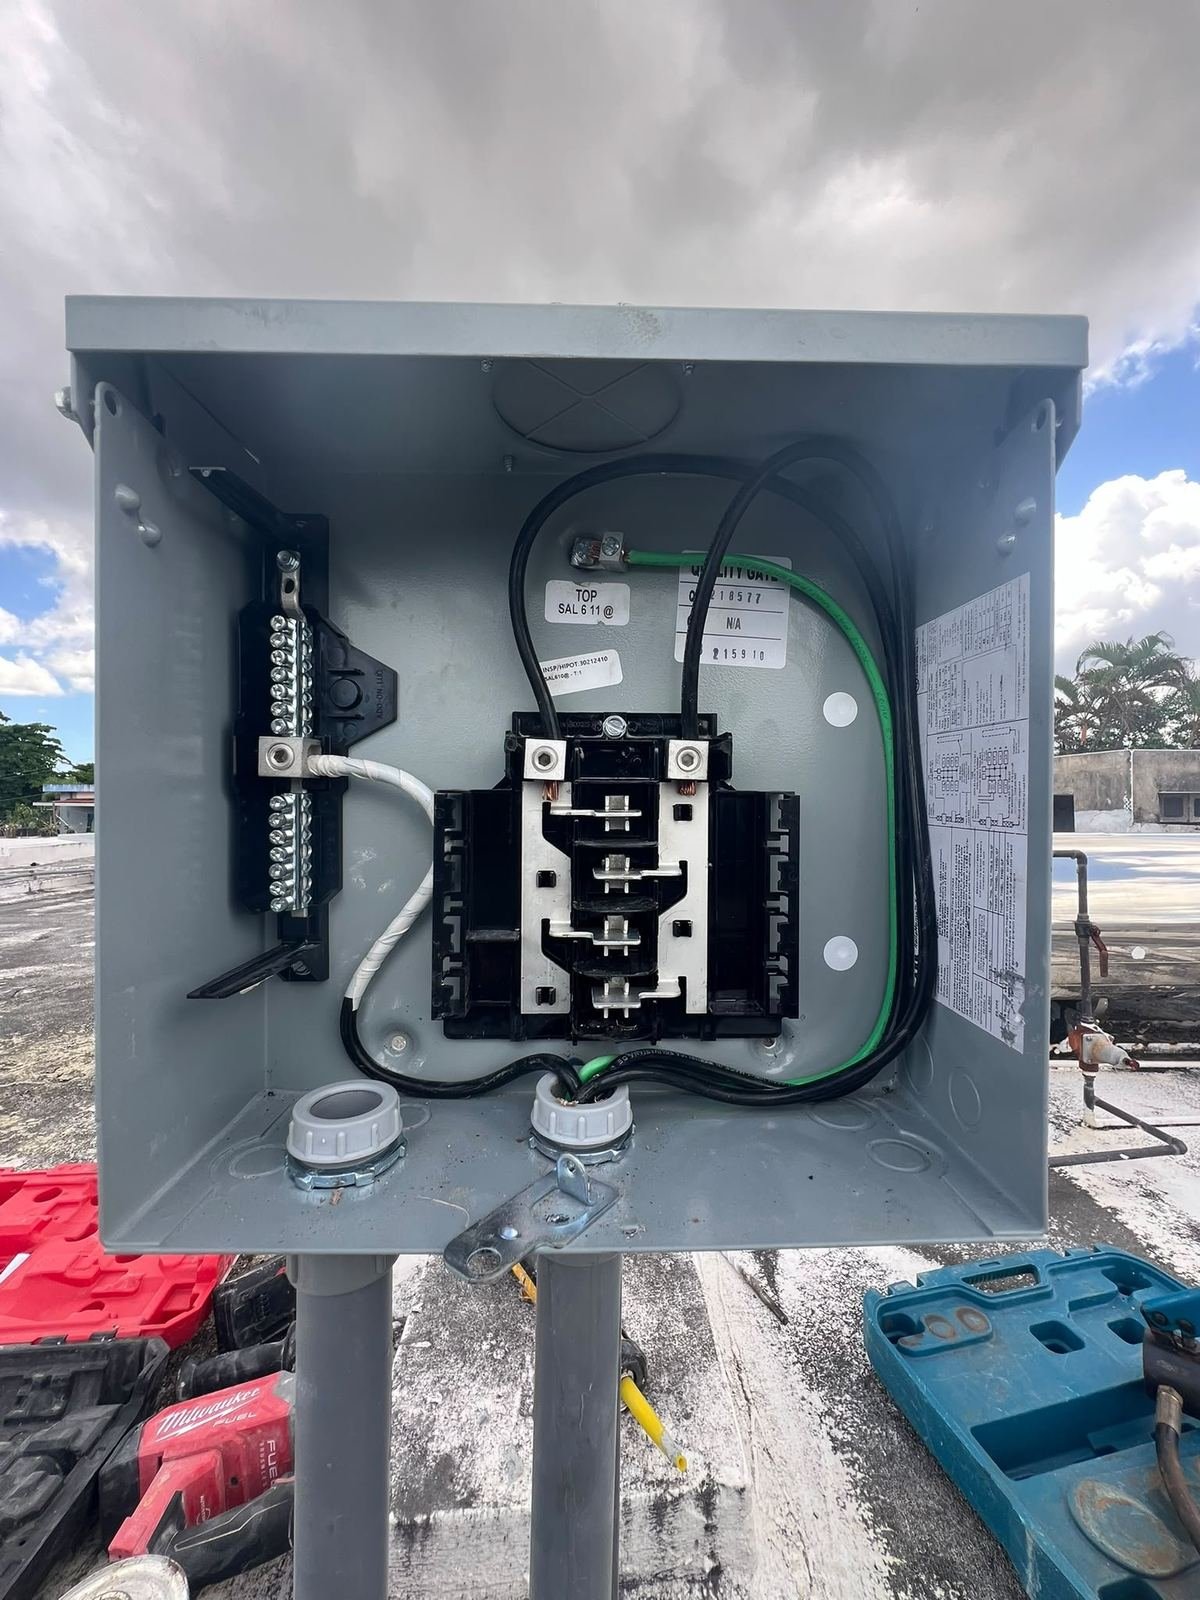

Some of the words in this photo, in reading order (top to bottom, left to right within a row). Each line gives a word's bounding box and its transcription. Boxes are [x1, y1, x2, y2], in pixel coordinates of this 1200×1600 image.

[691, 565, 742, 579] QLITY
[576, 589, 597, 602] TOP
[558, 603, 578, 615] SAL
[581, 604, 587, 615] 6
[590, 605, 600, 616] 11
[603, 605, 614, 619] @
[726, 616, 742, 630] N/A
[157, 1387, 260, 1436] Milwaukee
[213, 1411, 257, 1428] FUEL
